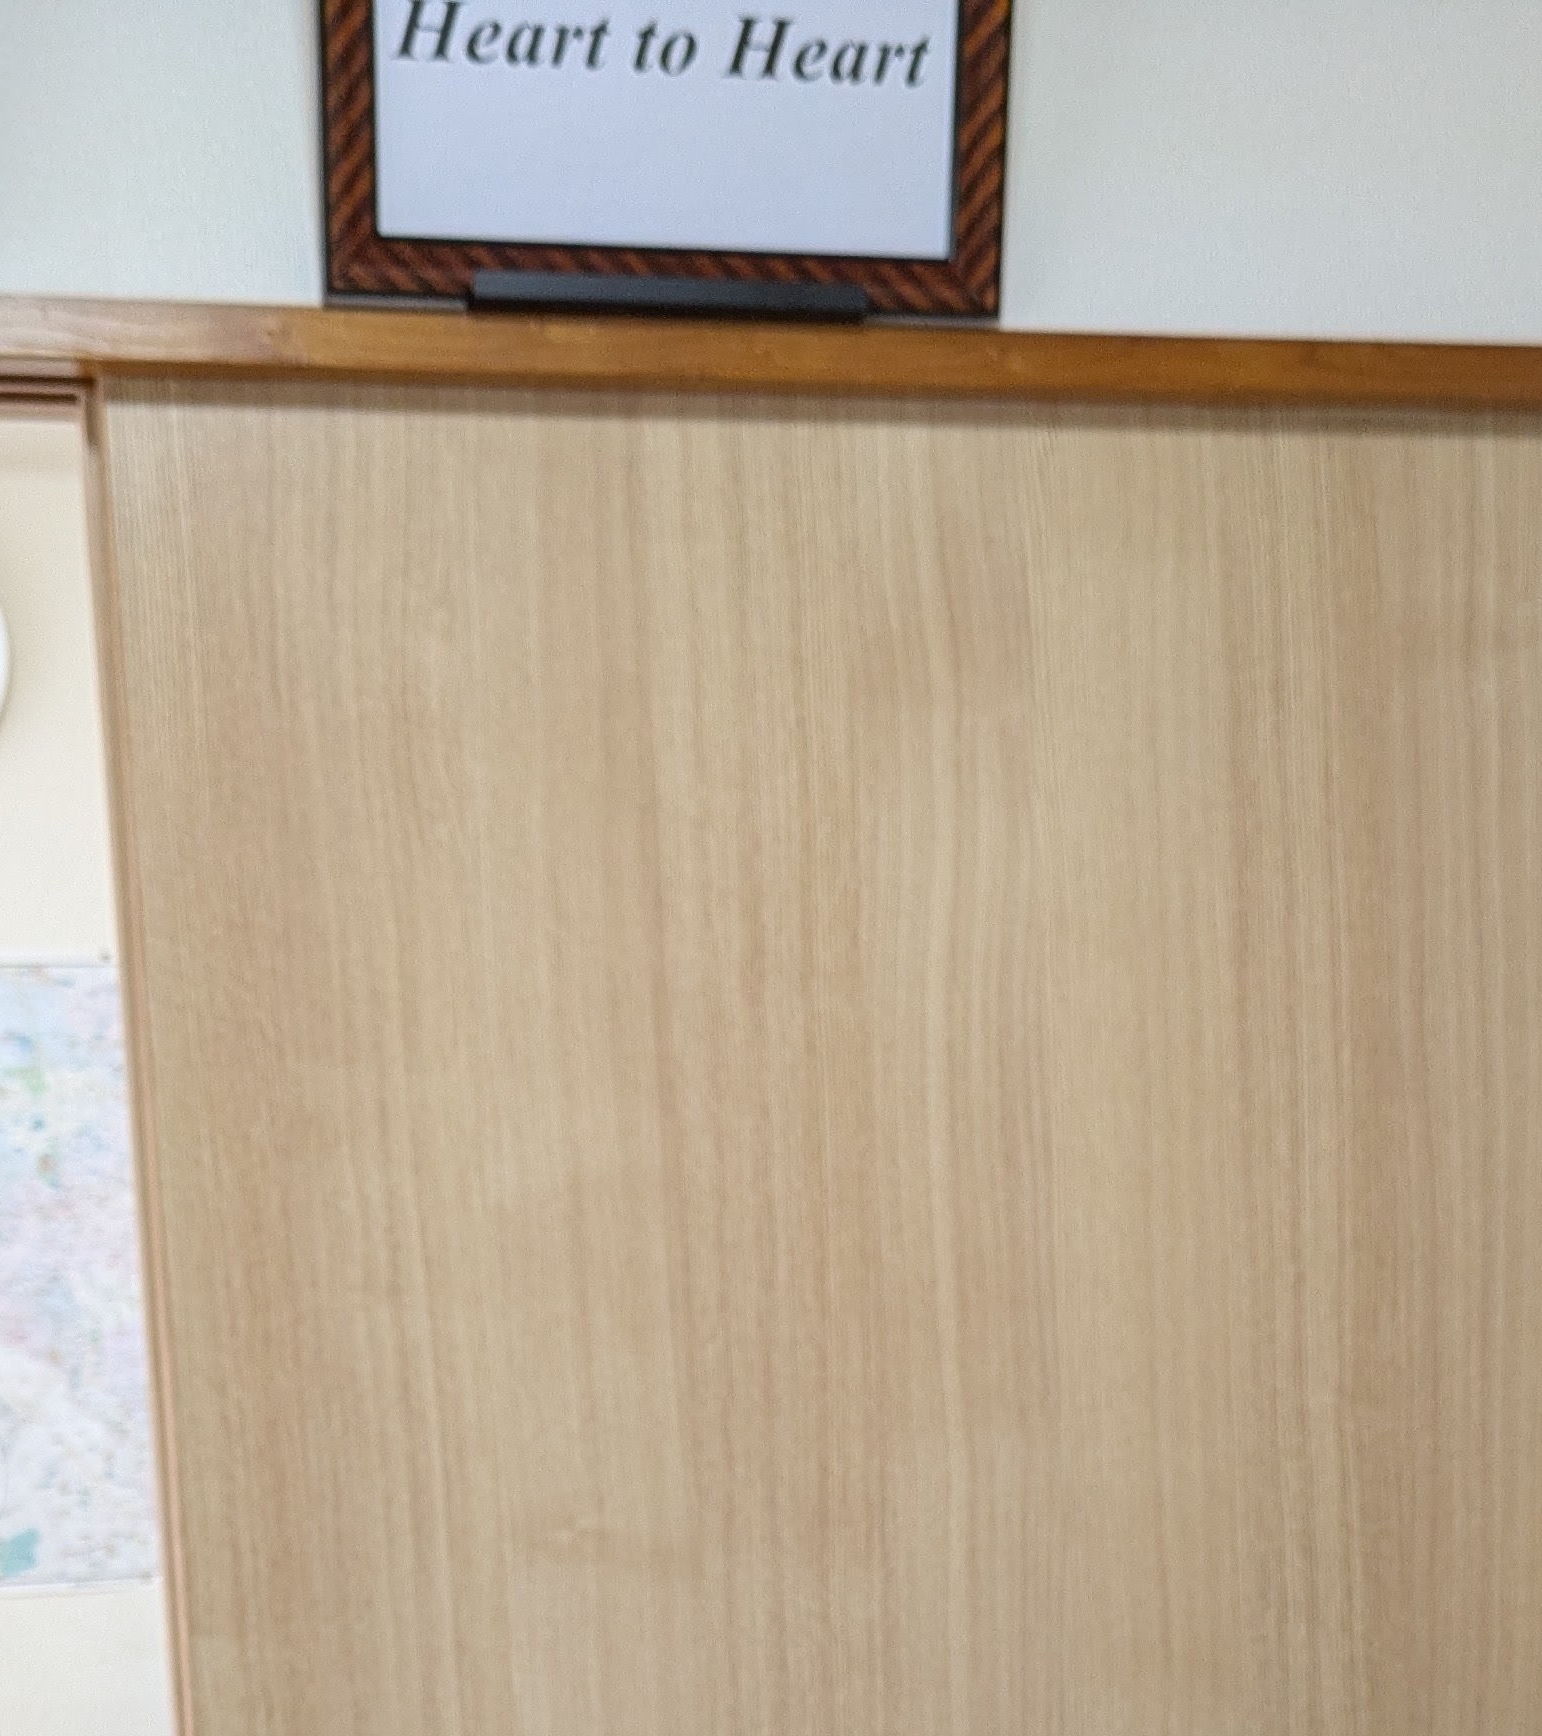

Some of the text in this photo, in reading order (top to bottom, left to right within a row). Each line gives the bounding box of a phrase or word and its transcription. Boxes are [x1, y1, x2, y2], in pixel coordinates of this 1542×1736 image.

[391, 0, 931, 88] Heart to Heart
